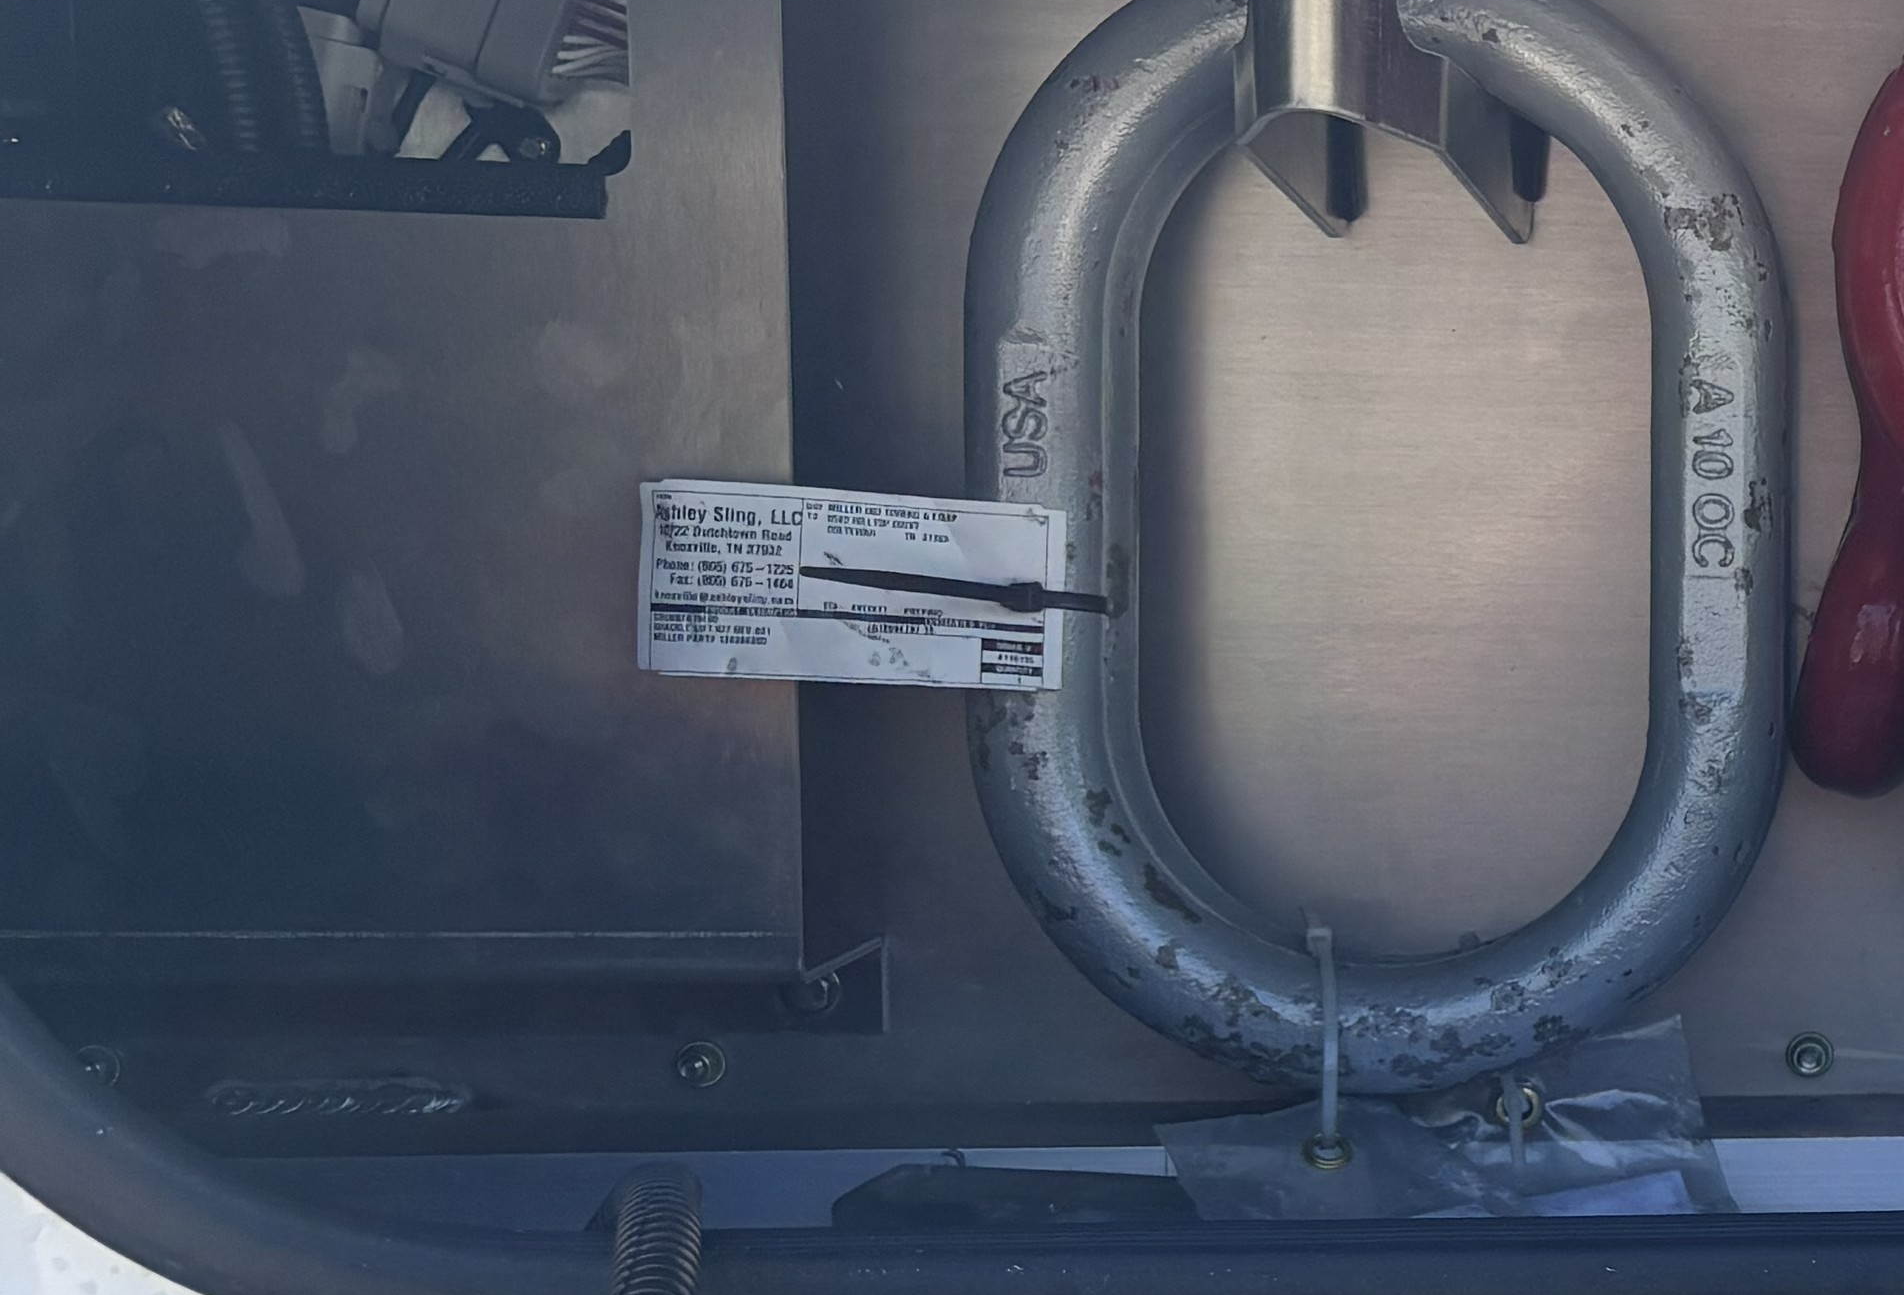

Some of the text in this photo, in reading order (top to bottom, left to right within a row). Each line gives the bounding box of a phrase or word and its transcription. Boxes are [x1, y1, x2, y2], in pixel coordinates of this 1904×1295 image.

[1001, 370, 1050, 478] USA
[655, 504, 803, 527] Ashley Sling, LLC
[762, 529, 792, 542] Road
[727, 543, 743, 555] TN
